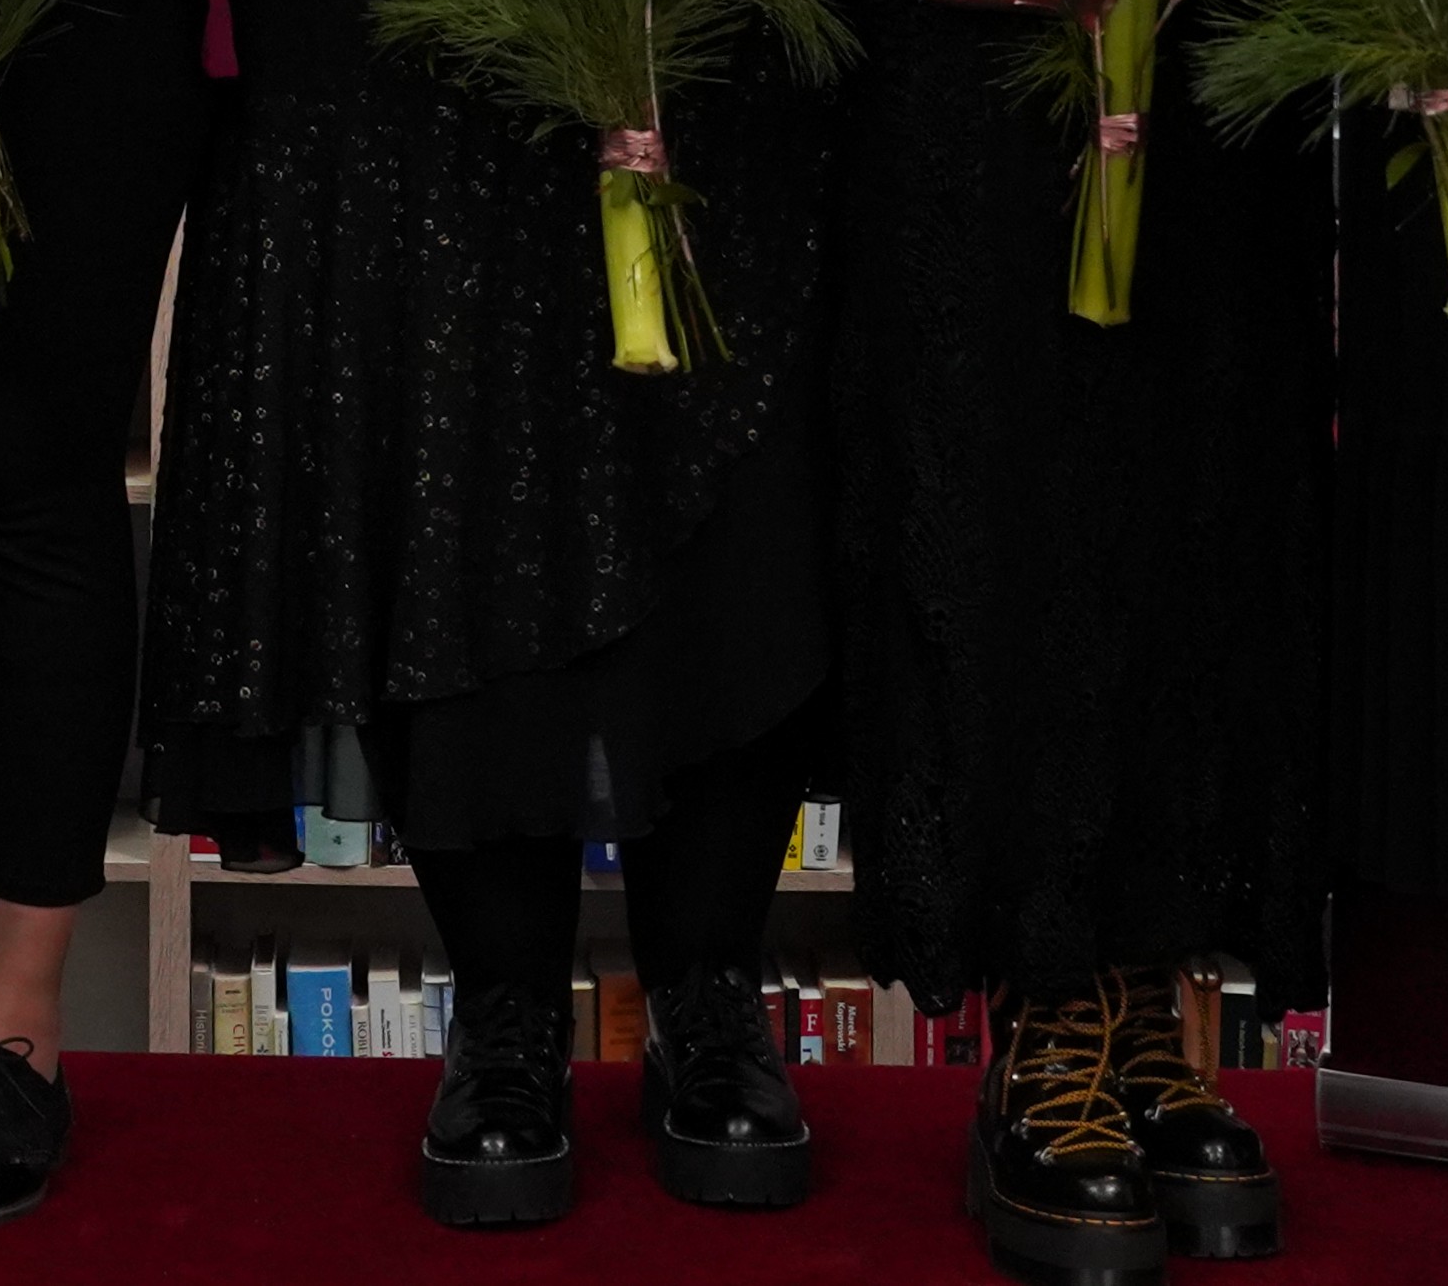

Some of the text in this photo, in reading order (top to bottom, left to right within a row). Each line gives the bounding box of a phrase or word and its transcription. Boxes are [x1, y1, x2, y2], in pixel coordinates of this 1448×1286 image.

[806, 1014, 819, 1032] F
[837, 1001, 847, 1053] Koprowski
[847, 1005, 858, 1035] Marek
